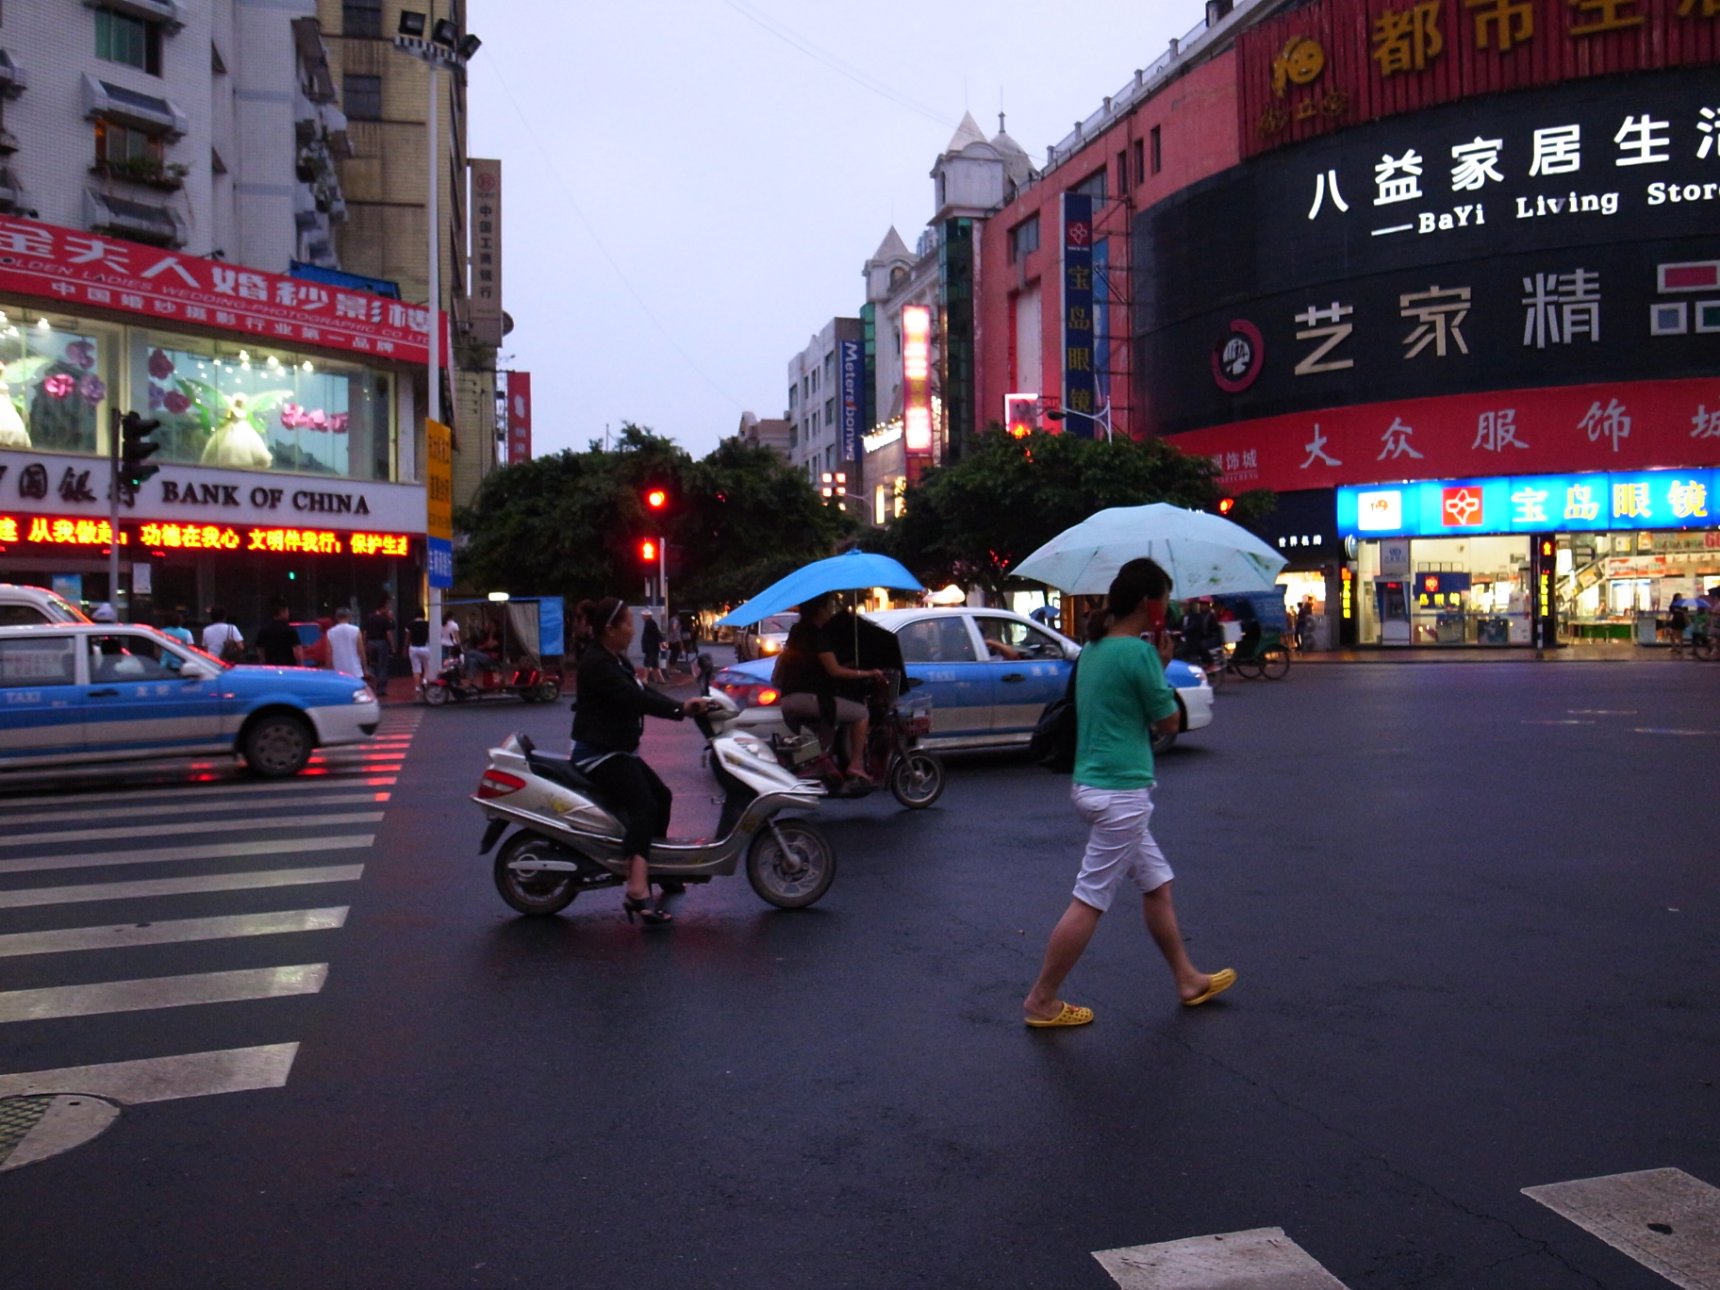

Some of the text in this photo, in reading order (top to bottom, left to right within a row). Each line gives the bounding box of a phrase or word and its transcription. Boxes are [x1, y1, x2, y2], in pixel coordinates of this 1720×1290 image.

[1516, 191, 1619, 219] Living
[1648, 182, 1720, 205] Stor
[1068, 265, 1090, 413] 宝岛眼镜
[1294, 260, 1720, 376] 艺家精品
[0, 463, 135, 508] 国银
[162, 481, 370, 515] BANK OF CHINA
[1511, 480, 1708, 523] 宝岛眼镜
